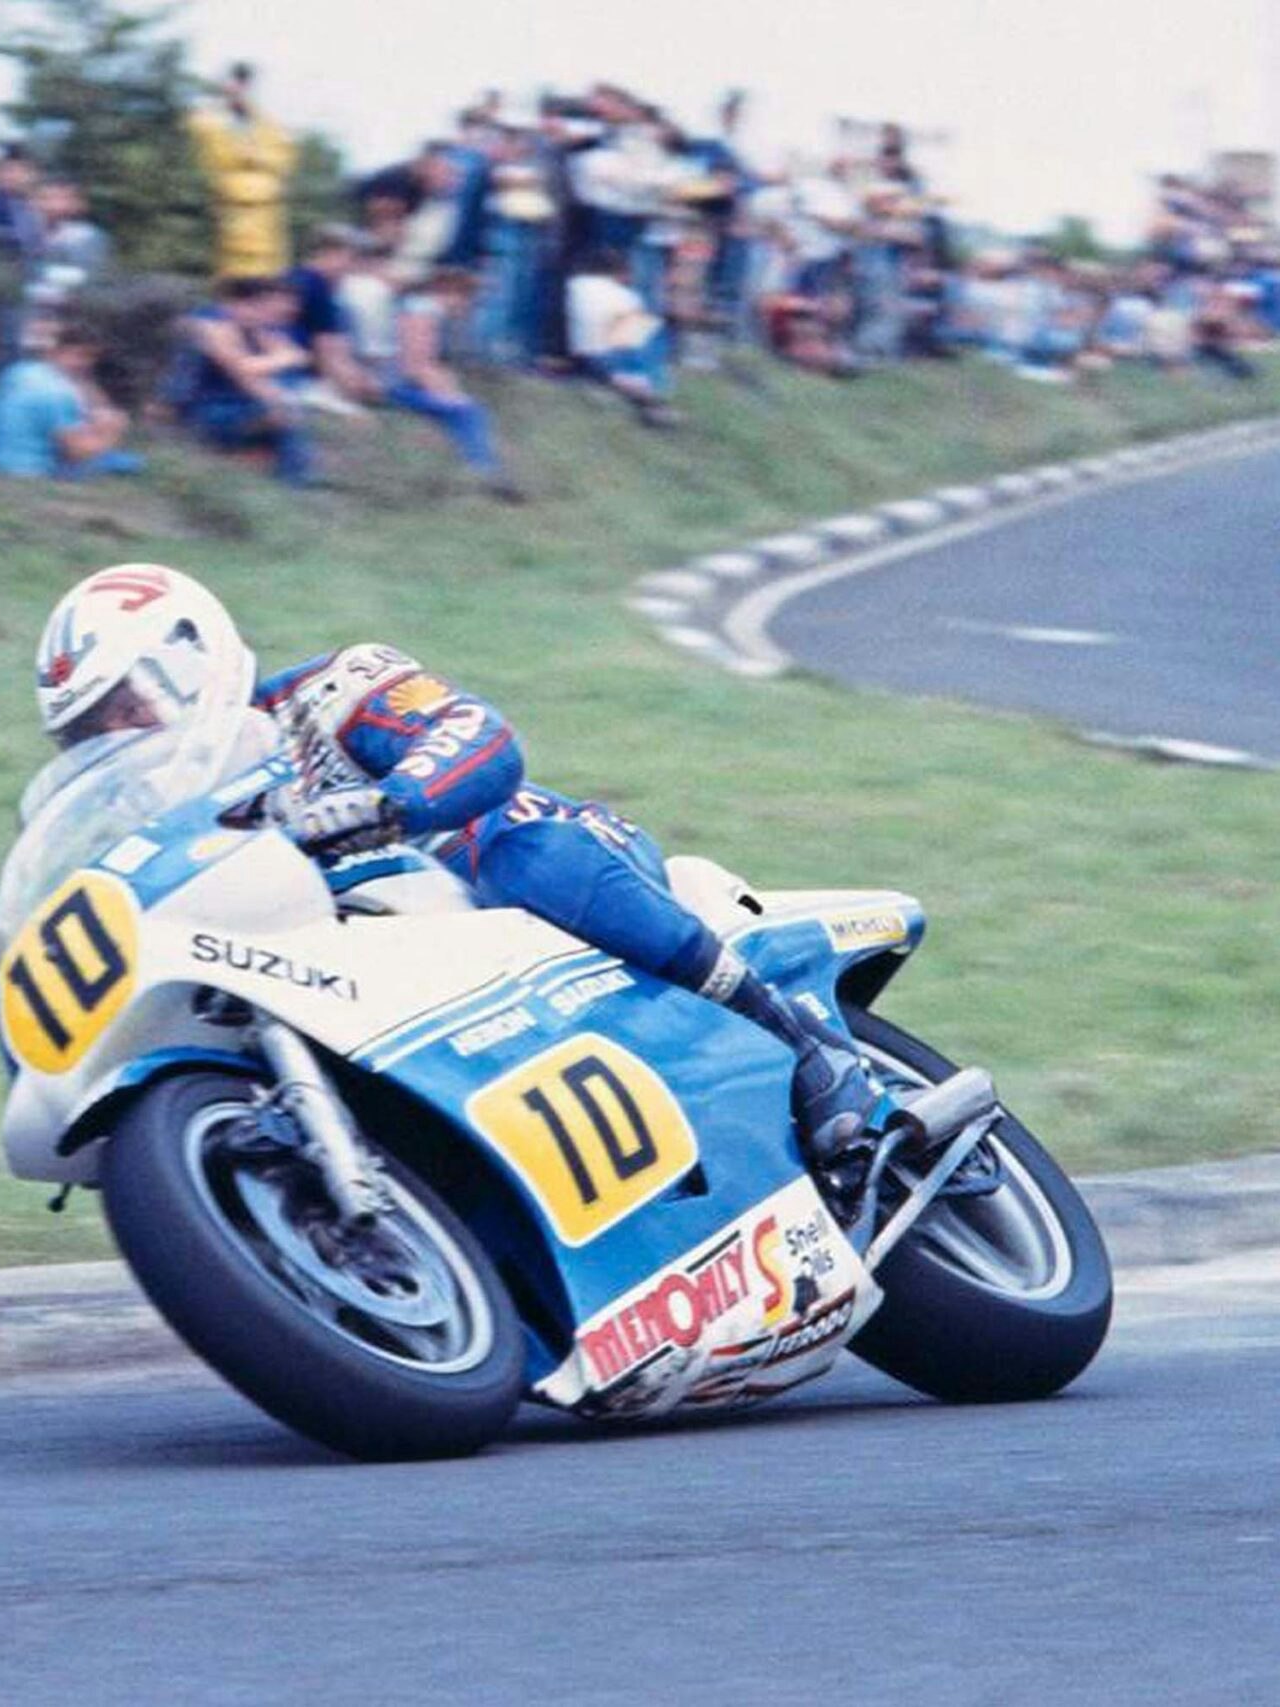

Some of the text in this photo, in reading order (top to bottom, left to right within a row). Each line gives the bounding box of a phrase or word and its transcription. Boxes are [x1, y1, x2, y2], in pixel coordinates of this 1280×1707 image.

[7, 886, 128, 1053] 10
[192, 933, 358, 1001] SUZUKI
[521, 1054, 658, 1205] 10
